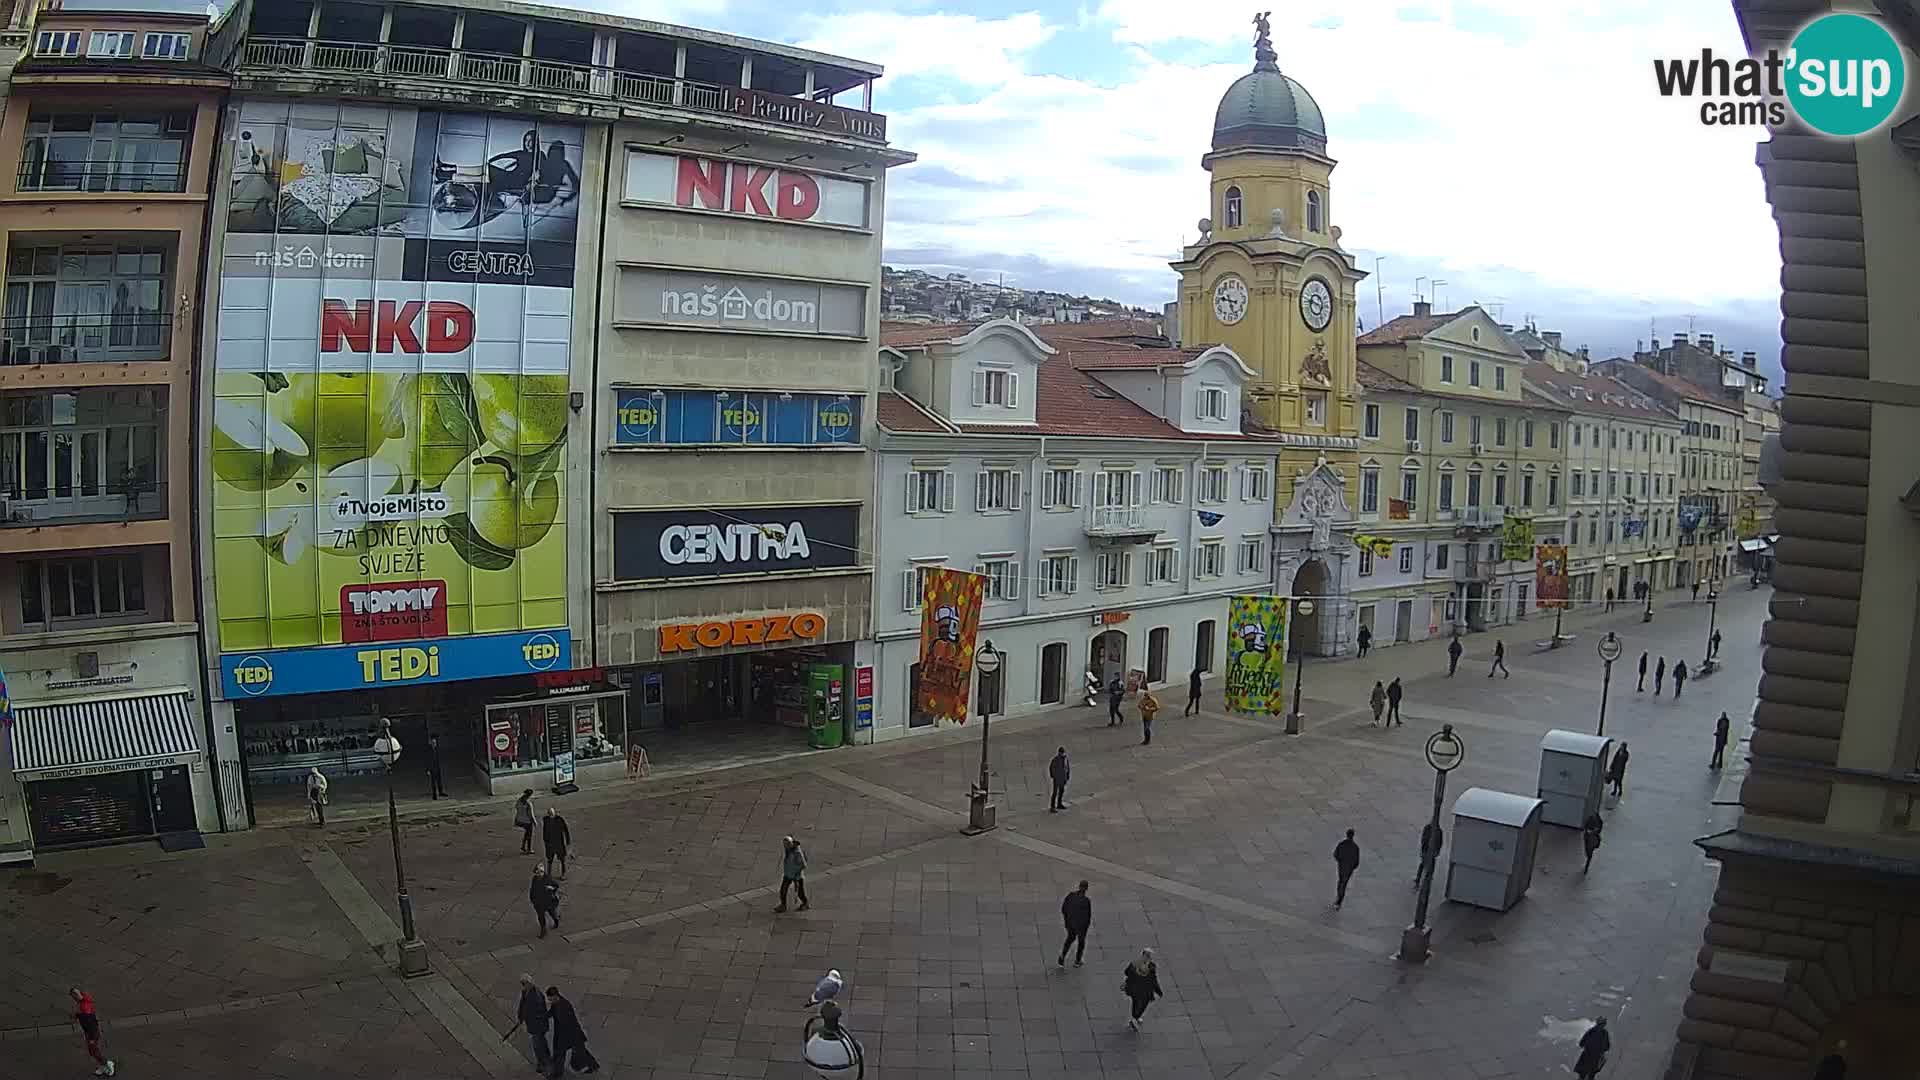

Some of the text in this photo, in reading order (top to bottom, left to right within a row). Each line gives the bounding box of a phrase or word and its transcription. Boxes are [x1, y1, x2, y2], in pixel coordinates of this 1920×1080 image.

[723, 89, 745, 113] Le
[676, 157, 820, 221] NKD
[256, 246, 366, 269] naš dom
[448, 250, 536, 276] CENTRA
[661, 283, 816, 323] naš dom
[321, 298, 476, 354] NKD
[619, 408, 658, 425] TEDi
[724, 409, 760, 426] TEDi
[338, 497, 446, 517] #TvojeMisto
[333, 524, 451, 550] ZA DNEVNO
[659, 521, 810, 564] CENTRA
[359, 547, 427, 576] SVJEŽE
[348, 587, 439, 615] TOMMY
[660, 613, 826, 653] KORZO
[234, 643, 560, 684] TEDi TEDi TEDi
